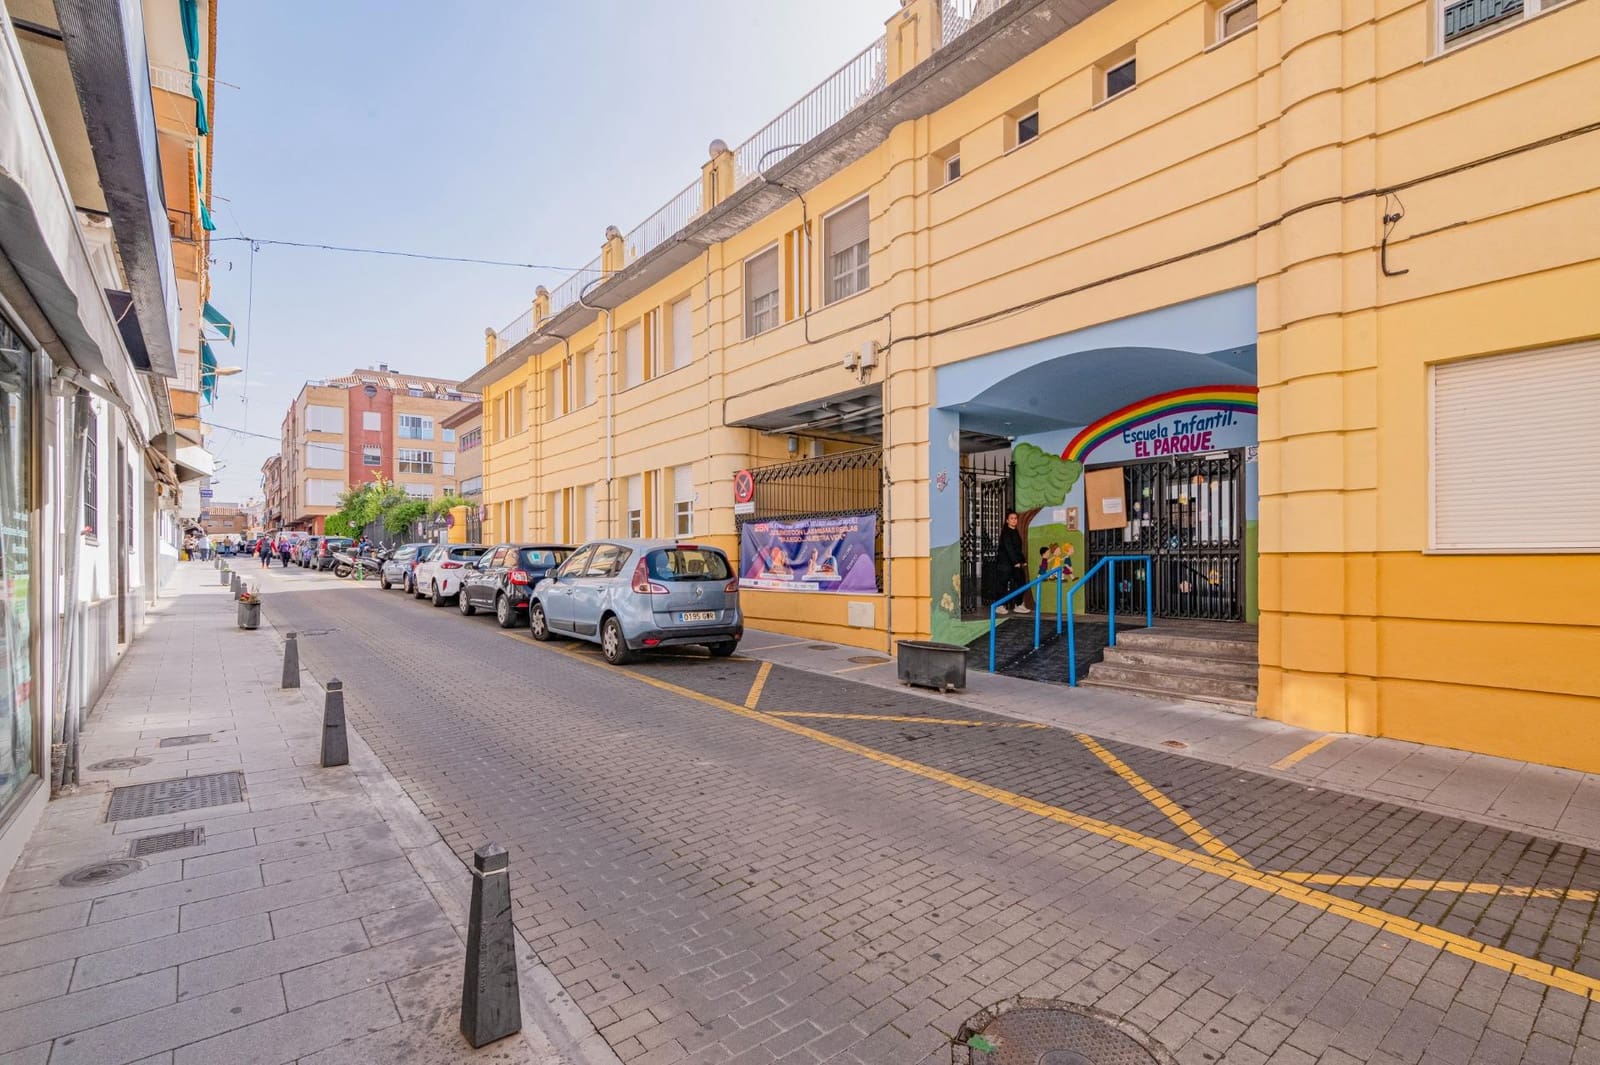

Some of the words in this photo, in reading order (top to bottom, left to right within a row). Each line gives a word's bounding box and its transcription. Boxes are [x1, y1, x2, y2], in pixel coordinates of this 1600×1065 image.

[1122, 423, 1168, 444] Escuela
[1173, 410, 1238, 436] Infantil.
[1135, 441, 1150, 458] EL
[1154, 431, 1215, 456] PARQUE.
